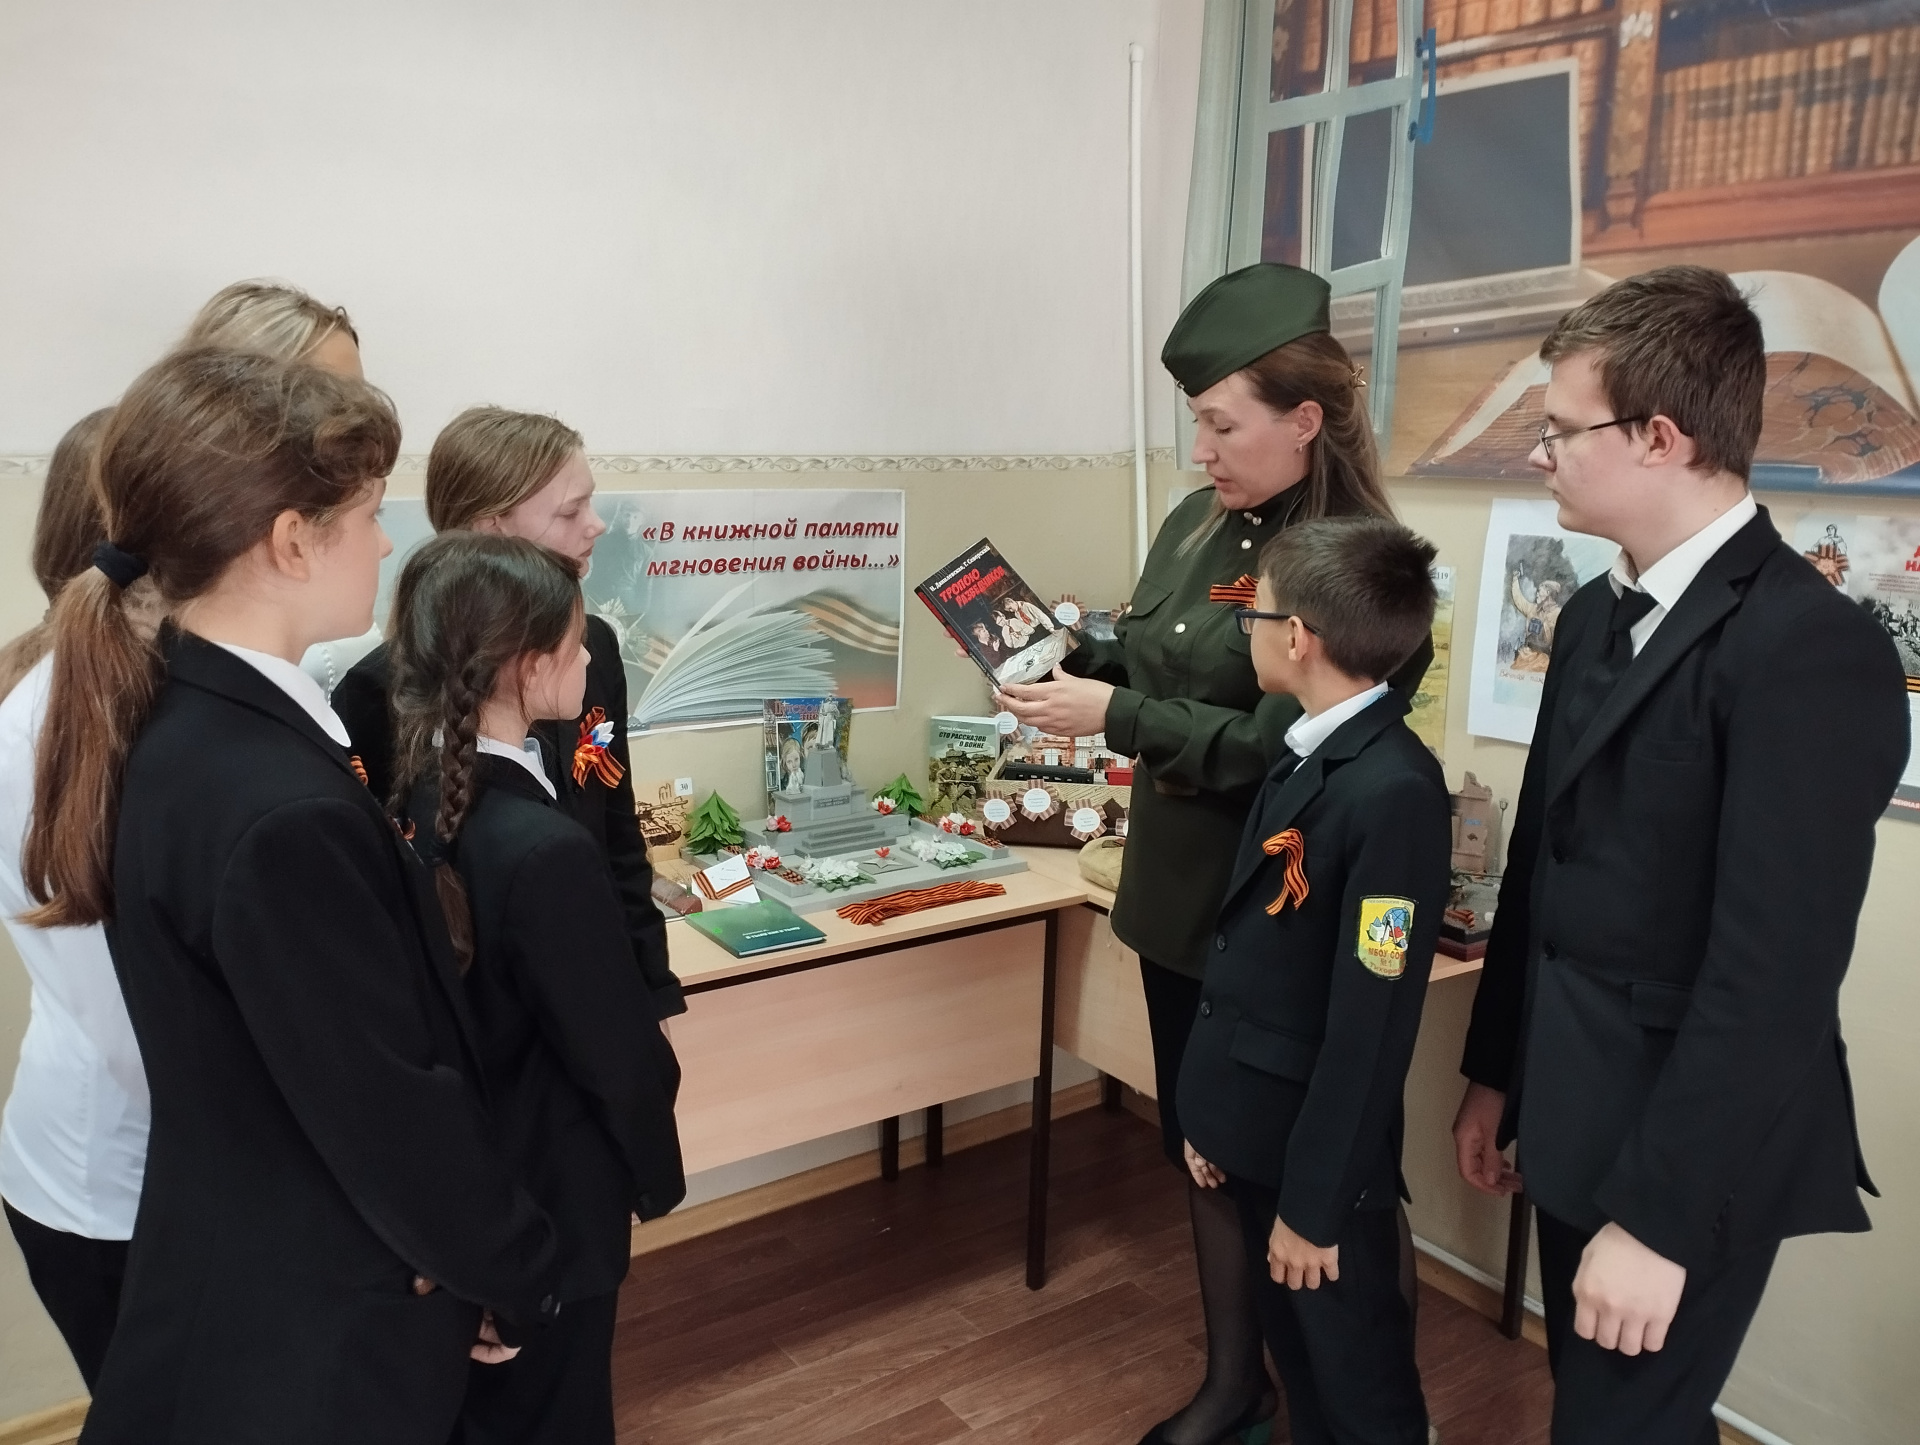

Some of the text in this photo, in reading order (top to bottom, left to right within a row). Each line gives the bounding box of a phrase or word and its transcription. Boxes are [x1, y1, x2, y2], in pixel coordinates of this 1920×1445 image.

[642, 517, 899, 543] «В книжной памяти
[646, 549, 901, 577] мгновения войны...»
[938, 568, 980, 603] ТРОПОЮ
[955, 565, 1006, 608] РАЗВЕДЧИКОВ
[938, 731, 987, 743] СТО РАССКАЗОВ
[964, 740, 985, 749] ВОЙНЕ
